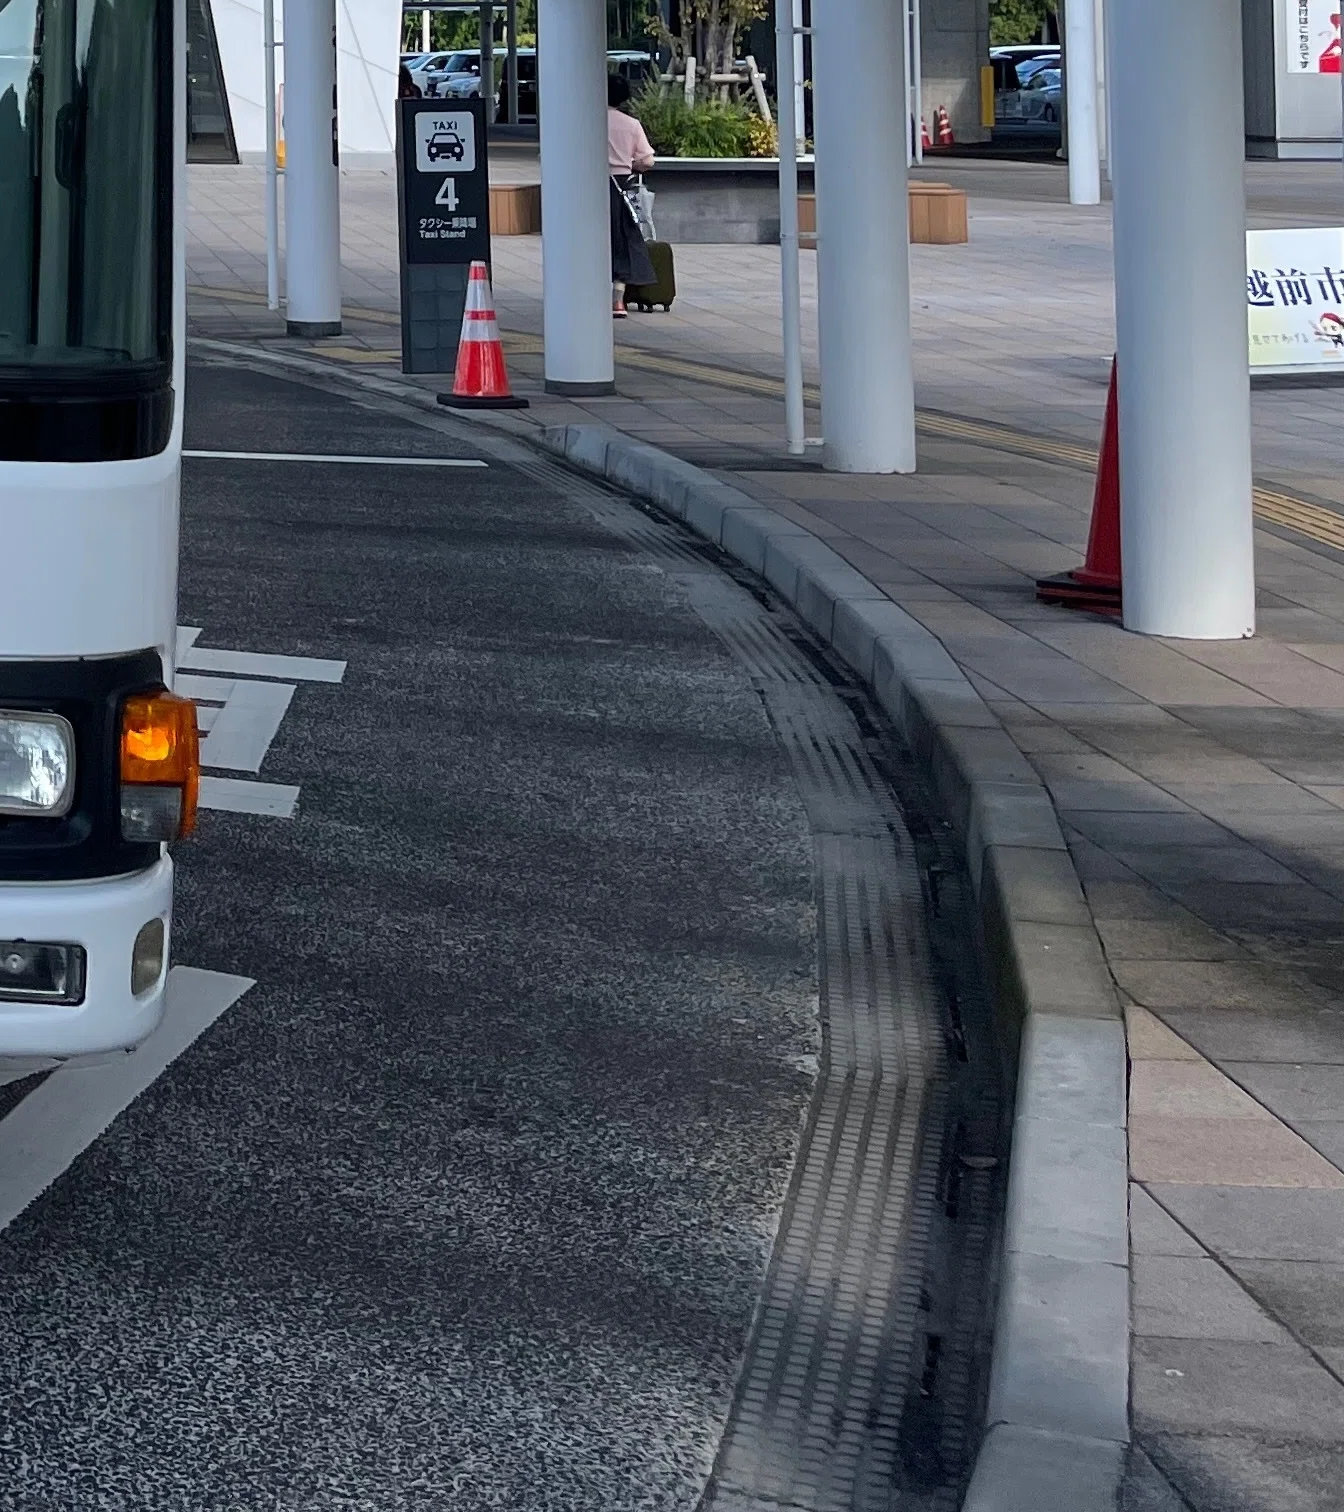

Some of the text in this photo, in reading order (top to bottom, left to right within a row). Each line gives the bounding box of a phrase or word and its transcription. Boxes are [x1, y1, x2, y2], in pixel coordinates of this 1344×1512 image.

[433, 121, 458, 130] TAXI
[435, 177, 460, 212] 4
[419, 229, 466, 239] Taxi Stand
